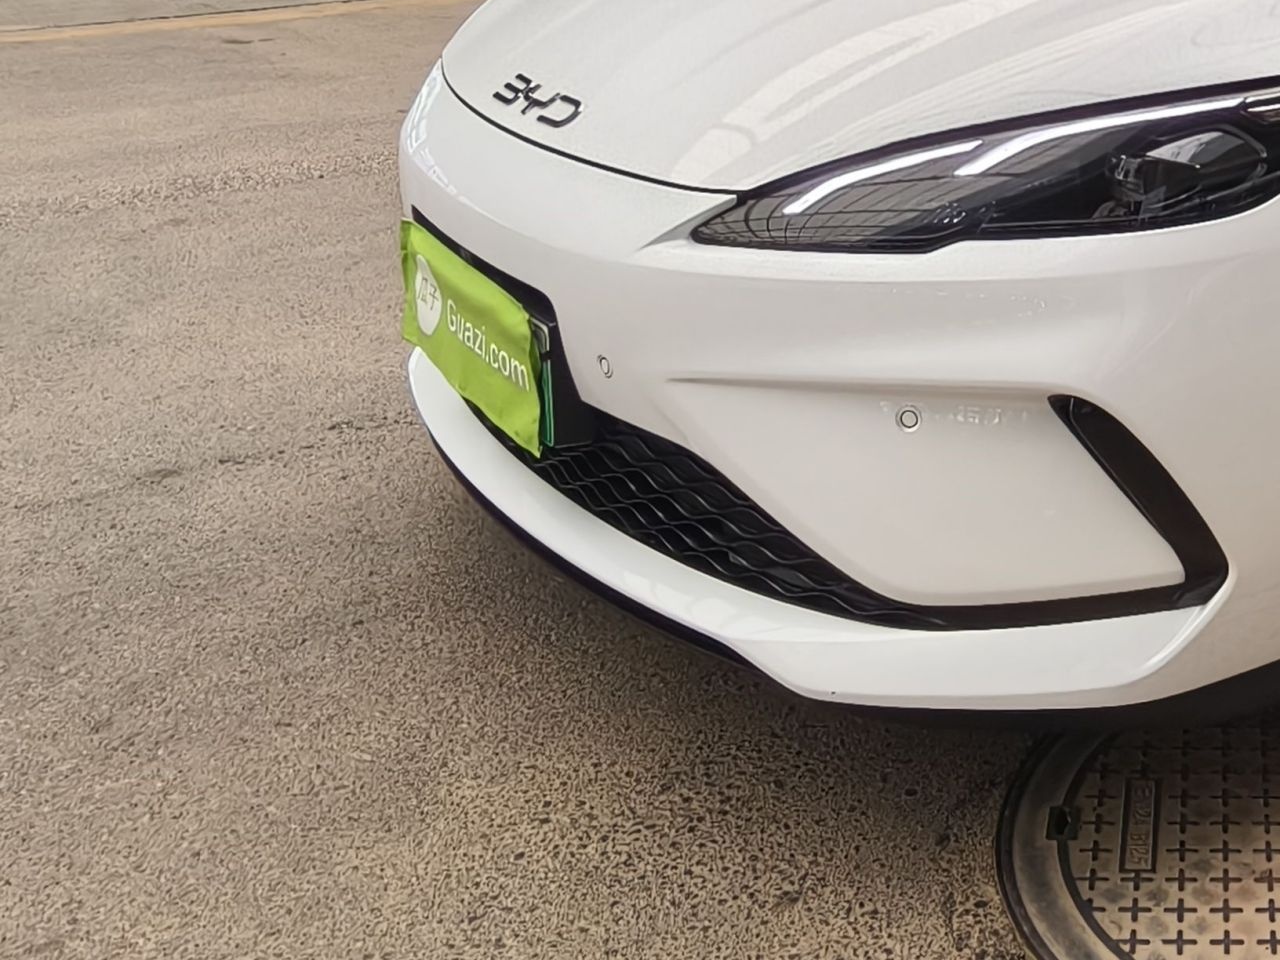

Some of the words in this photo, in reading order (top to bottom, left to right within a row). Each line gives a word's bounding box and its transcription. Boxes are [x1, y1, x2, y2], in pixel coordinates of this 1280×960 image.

[492, 73, 583, 128] BYD
[416, 276, 440, 312] 瓜子
[446, 299, 530, 392] Guazi.com
